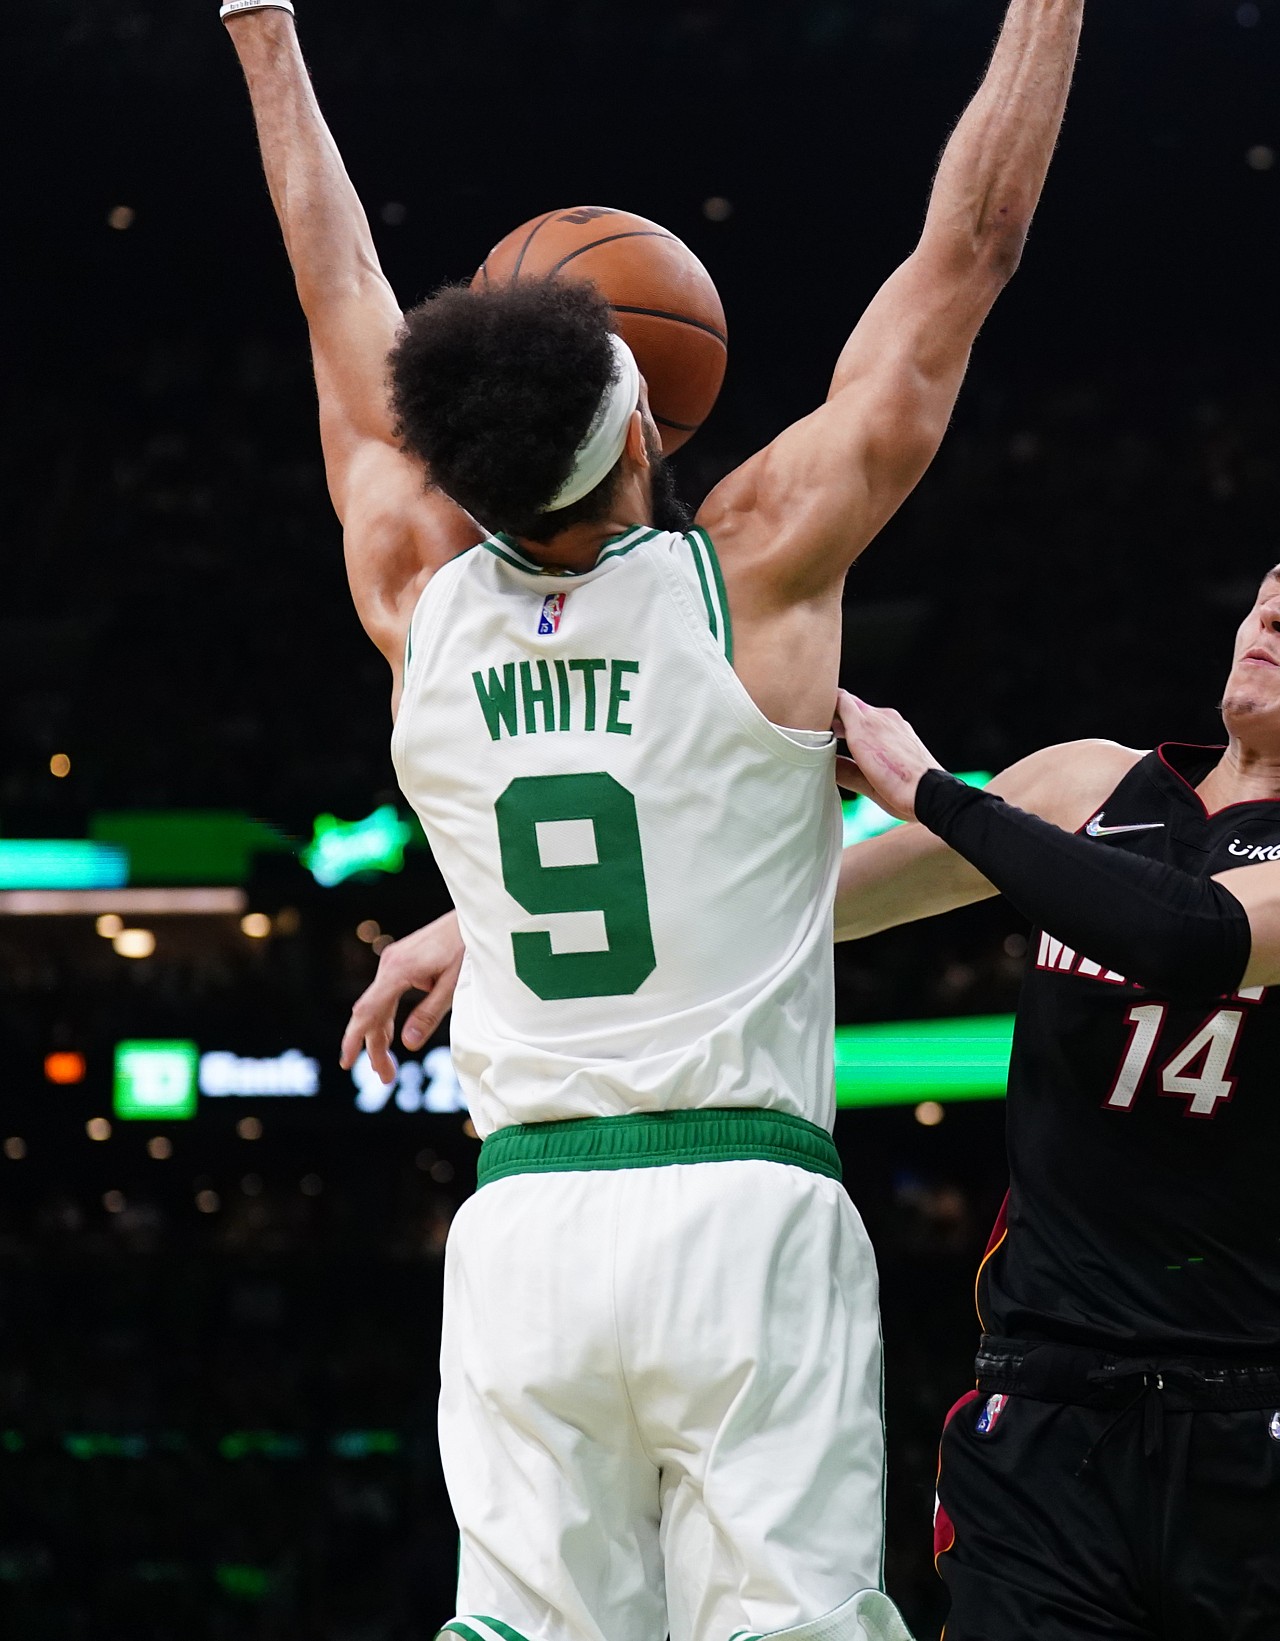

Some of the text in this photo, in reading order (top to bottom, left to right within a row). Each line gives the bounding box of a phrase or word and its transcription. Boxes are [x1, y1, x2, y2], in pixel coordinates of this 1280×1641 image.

[473, 659, 639, 741] WHITE
[495, 771, 657, 1001] 9
[1105, 1002, 1246, 1117] 14
